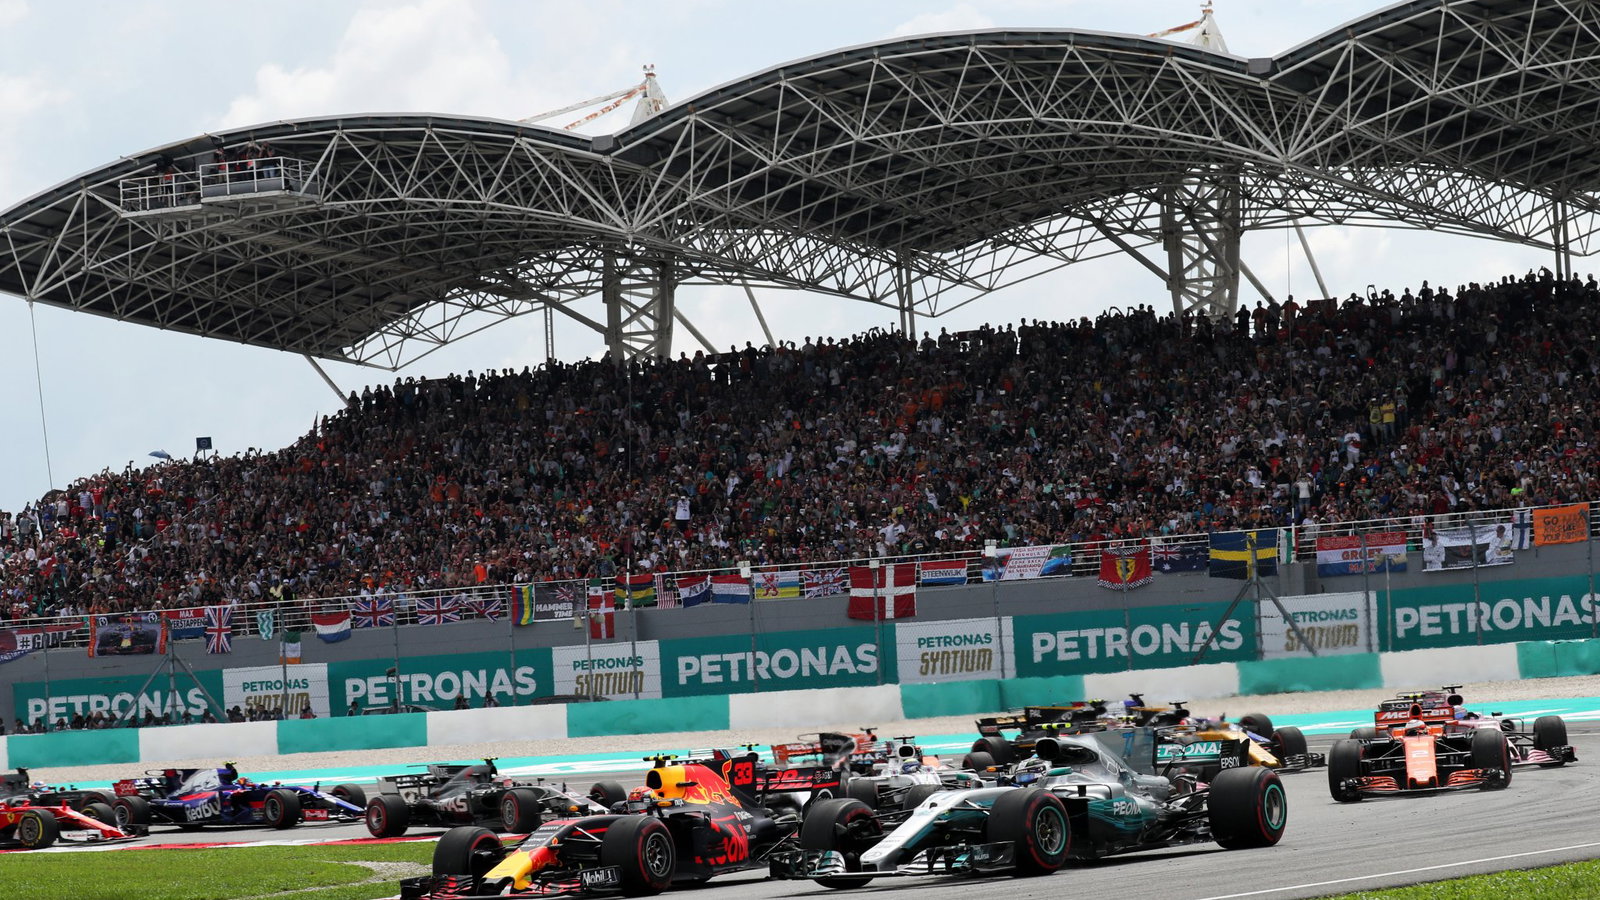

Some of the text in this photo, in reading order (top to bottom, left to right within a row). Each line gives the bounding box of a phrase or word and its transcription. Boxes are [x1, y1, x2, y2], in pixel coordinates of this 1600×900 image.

[179, 609, 195, 618] MAX
[535, 603, 573, 611] HAMMER
[553, 610, 573, 618] TIME
[1395, 593, 1600, 639] PETRONAS
[917, 633, 993, 649] PETRONAS
[1032, 619, 1243, 664] PETRONAS
[573, 656, 644, 671] PETRONAS
[677, 643, 878, 685] PETRONAS
[919, 648, 993, 676] SYNTIUM
[242, 679, 310, 692] PETRONAS
[345, 666, 537, 706] PETRONAS
[27, 687, 208, 727] PETRONAS
[1411, 750, 1429, 758] 2
[1220, 756, 1240, 769] EPSON
[734, 761, 753, 785] 33
[582, 870, 605, 886] Mobil
